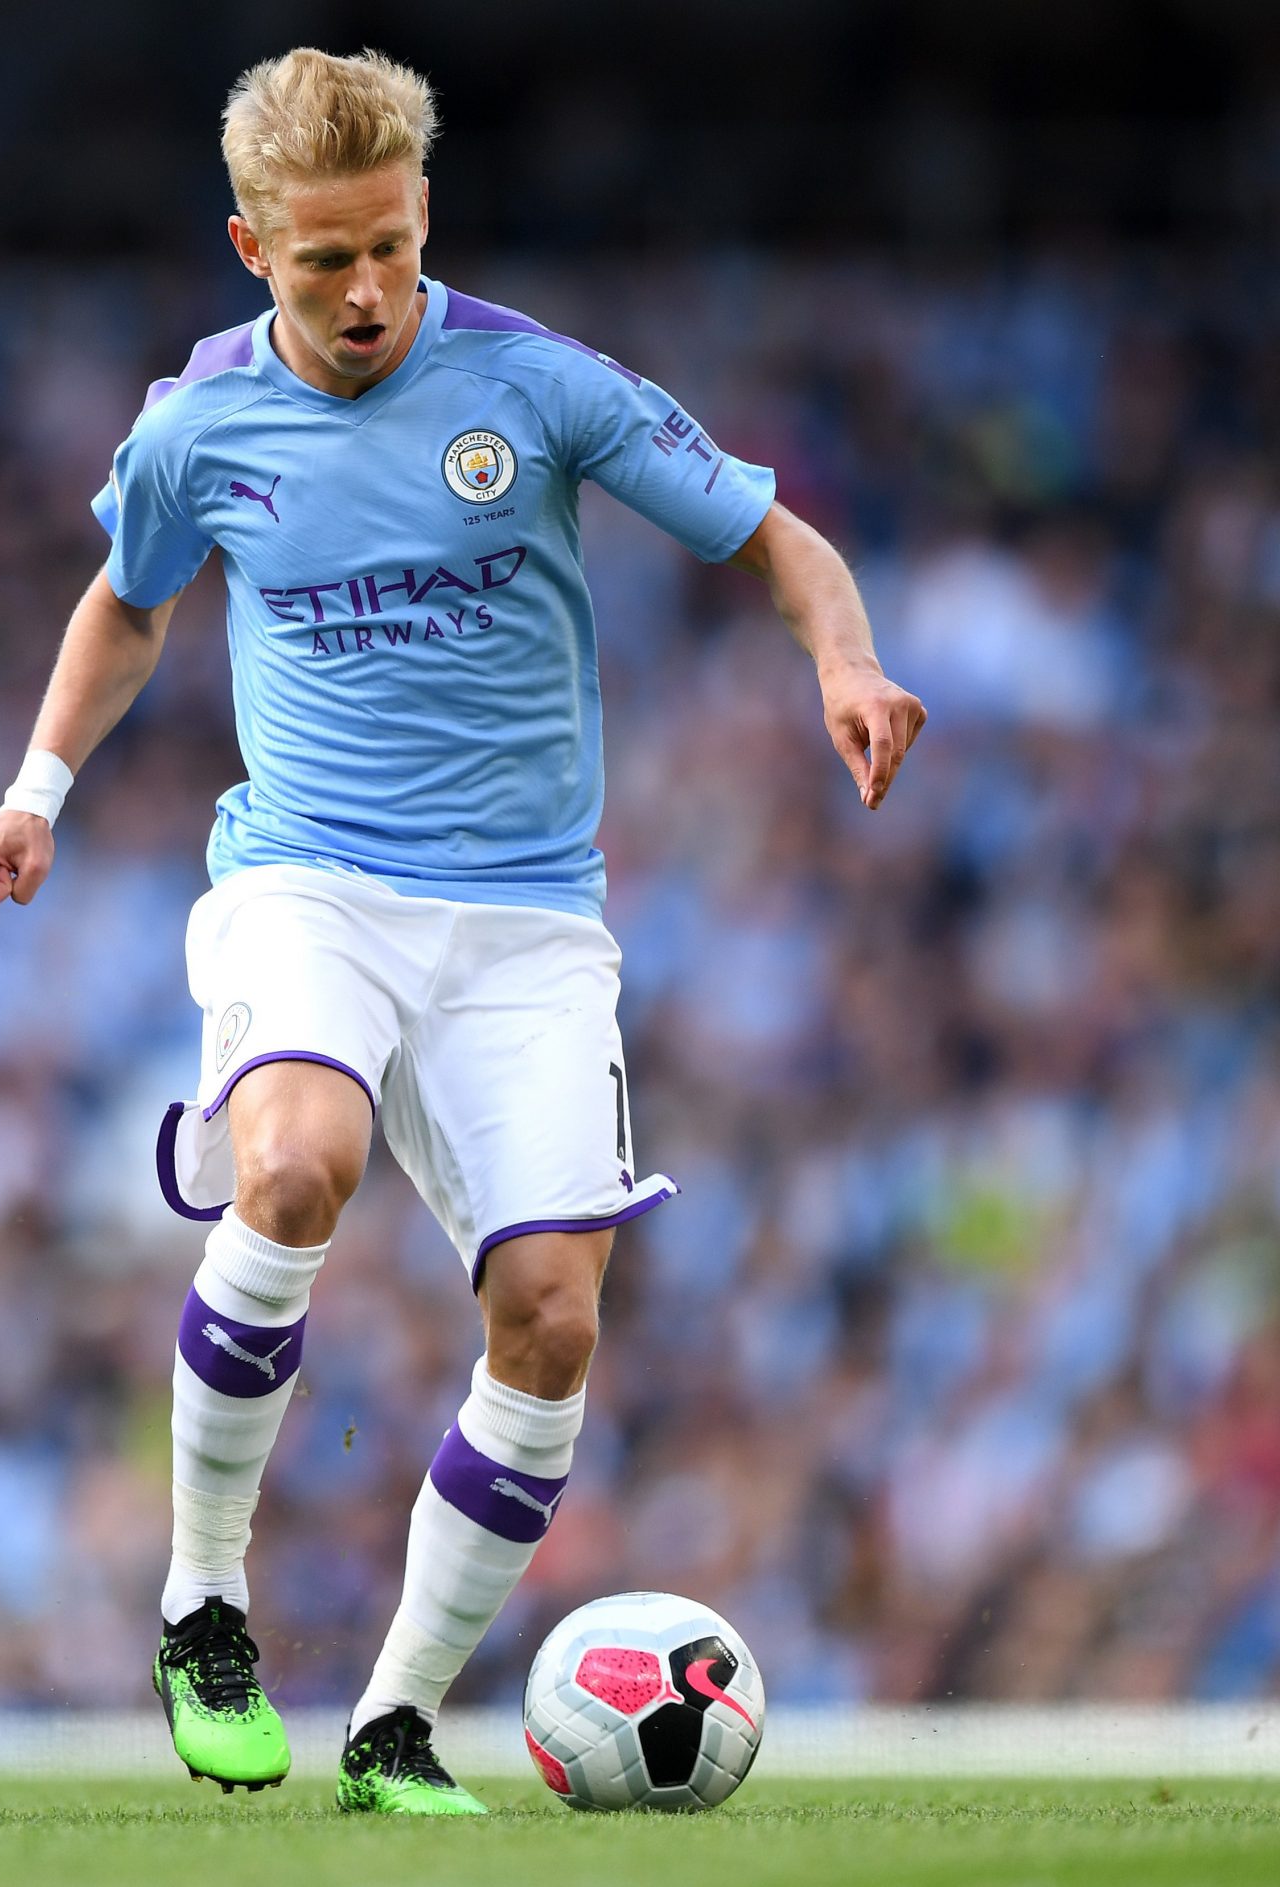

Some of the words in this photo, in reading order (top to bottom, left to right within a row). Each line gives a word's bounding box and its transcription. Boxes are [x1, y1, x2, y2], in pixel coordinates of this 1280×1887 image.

[448, 434, 506, 463] MANCHESTER
[475, 489, 497, 500] CITY
[463, 515, 481, 526] 125
[483, 507, 516, 522] YEARS
[259, 546, 527, 623] ETIHAD
[312, 604, 493, 655] AIRWAYS
